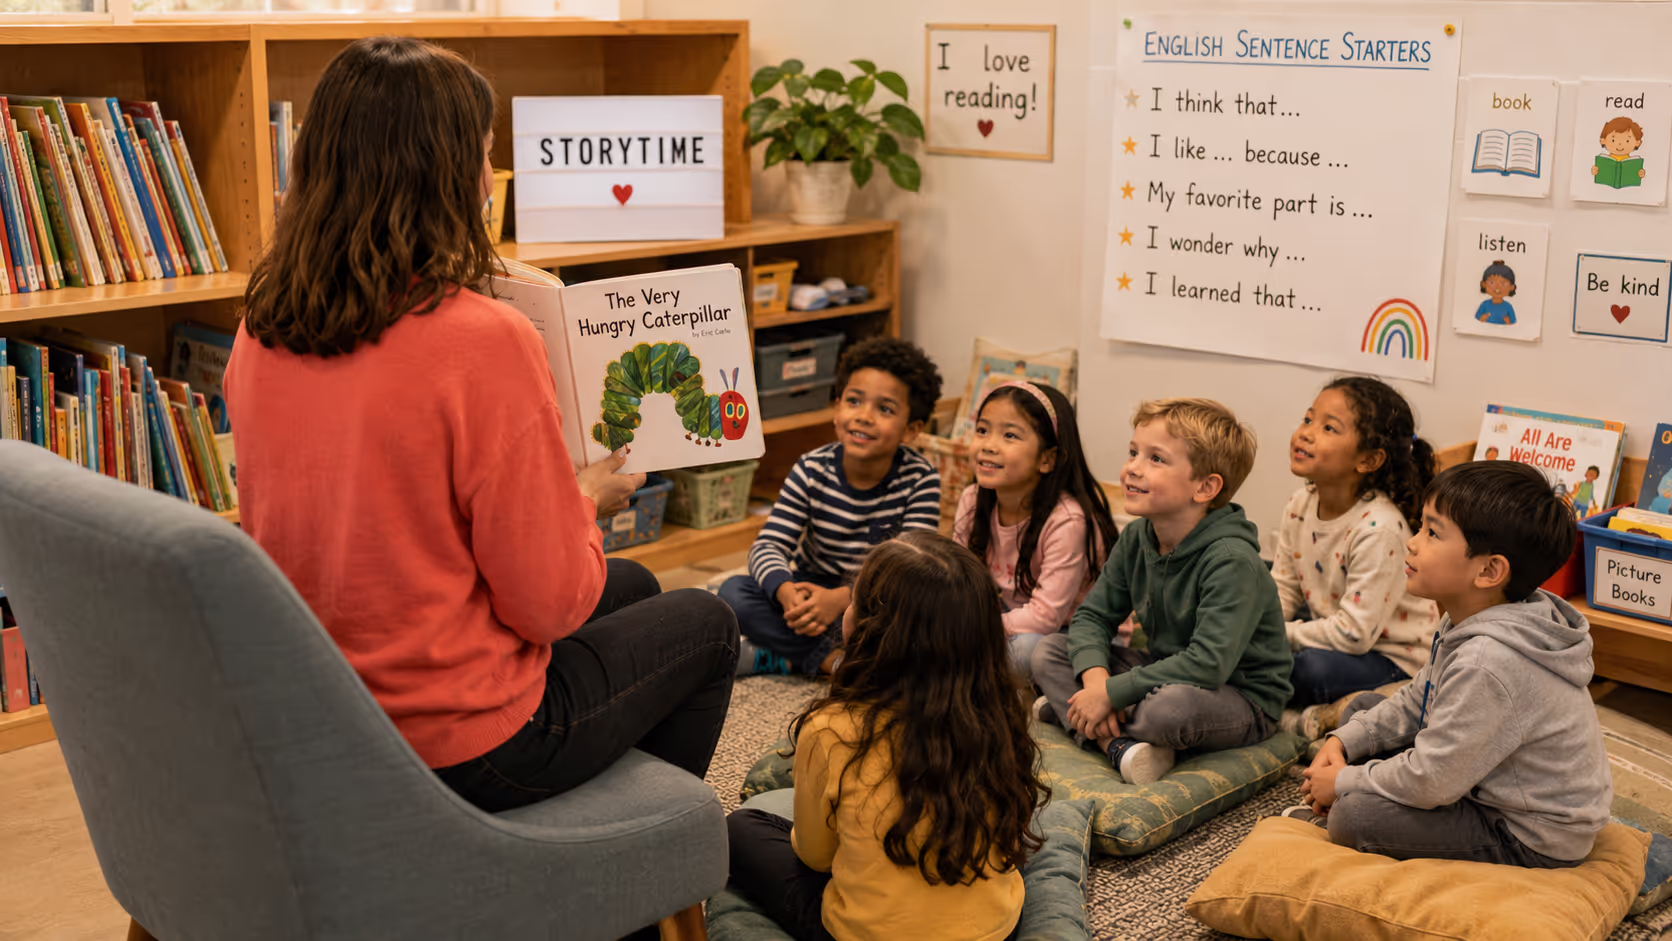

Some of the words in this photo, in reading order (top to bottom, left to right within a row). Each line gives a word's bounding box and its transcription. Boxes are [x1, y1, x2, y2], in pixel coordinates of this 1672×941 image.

[937, 42, 951, 71] I
[984, 44, 1031, 73] love
[1145, 31, 1223, 57] ENGLISH
[1236, 30, 1330, 60] SENTENCE
[1341, 32, 1432, 63] STARTERS
[945, 82, 1037, 120] reading!
[1150, 87, 1163, 112] I
[1176, 89, 1224, 114] think
[1492, 92, 1532, 110] book
[1605, 92, 1645, 110] read
[541, 136, 704, 166] STORYTIME
[1150, 134, 1161, 158] I
[1147, 181, 1175, 212] My
[1186, 182, 1262, 210] favorite
[1273, 193, 1318, 220] part
[1147, 226, 1159, 250] I
[1169, 232, 1234, 256] wonder
[1478, 233, 1526, 254] listen
[1145, 271, 1157, 296] I
[1172, 276, 1241, 303] learned
[1587, 273, 1610, 292] Be
[1620, 275, 1660, 297] kind
[605, 292, 635, 310] The
[641, 288, 680, 308] Very
[578, 318, 636, 339] Hungry
[642, 304, 732, 329] Caterpillar
[1520, 428, 1542, 447] All
[1544, 432, 1572, 451] Are
[1510, 446, 1576, 473] Welcome
[1607, 559, 1661, 584] Picture
[1611, 583, 1655, 606] Books
